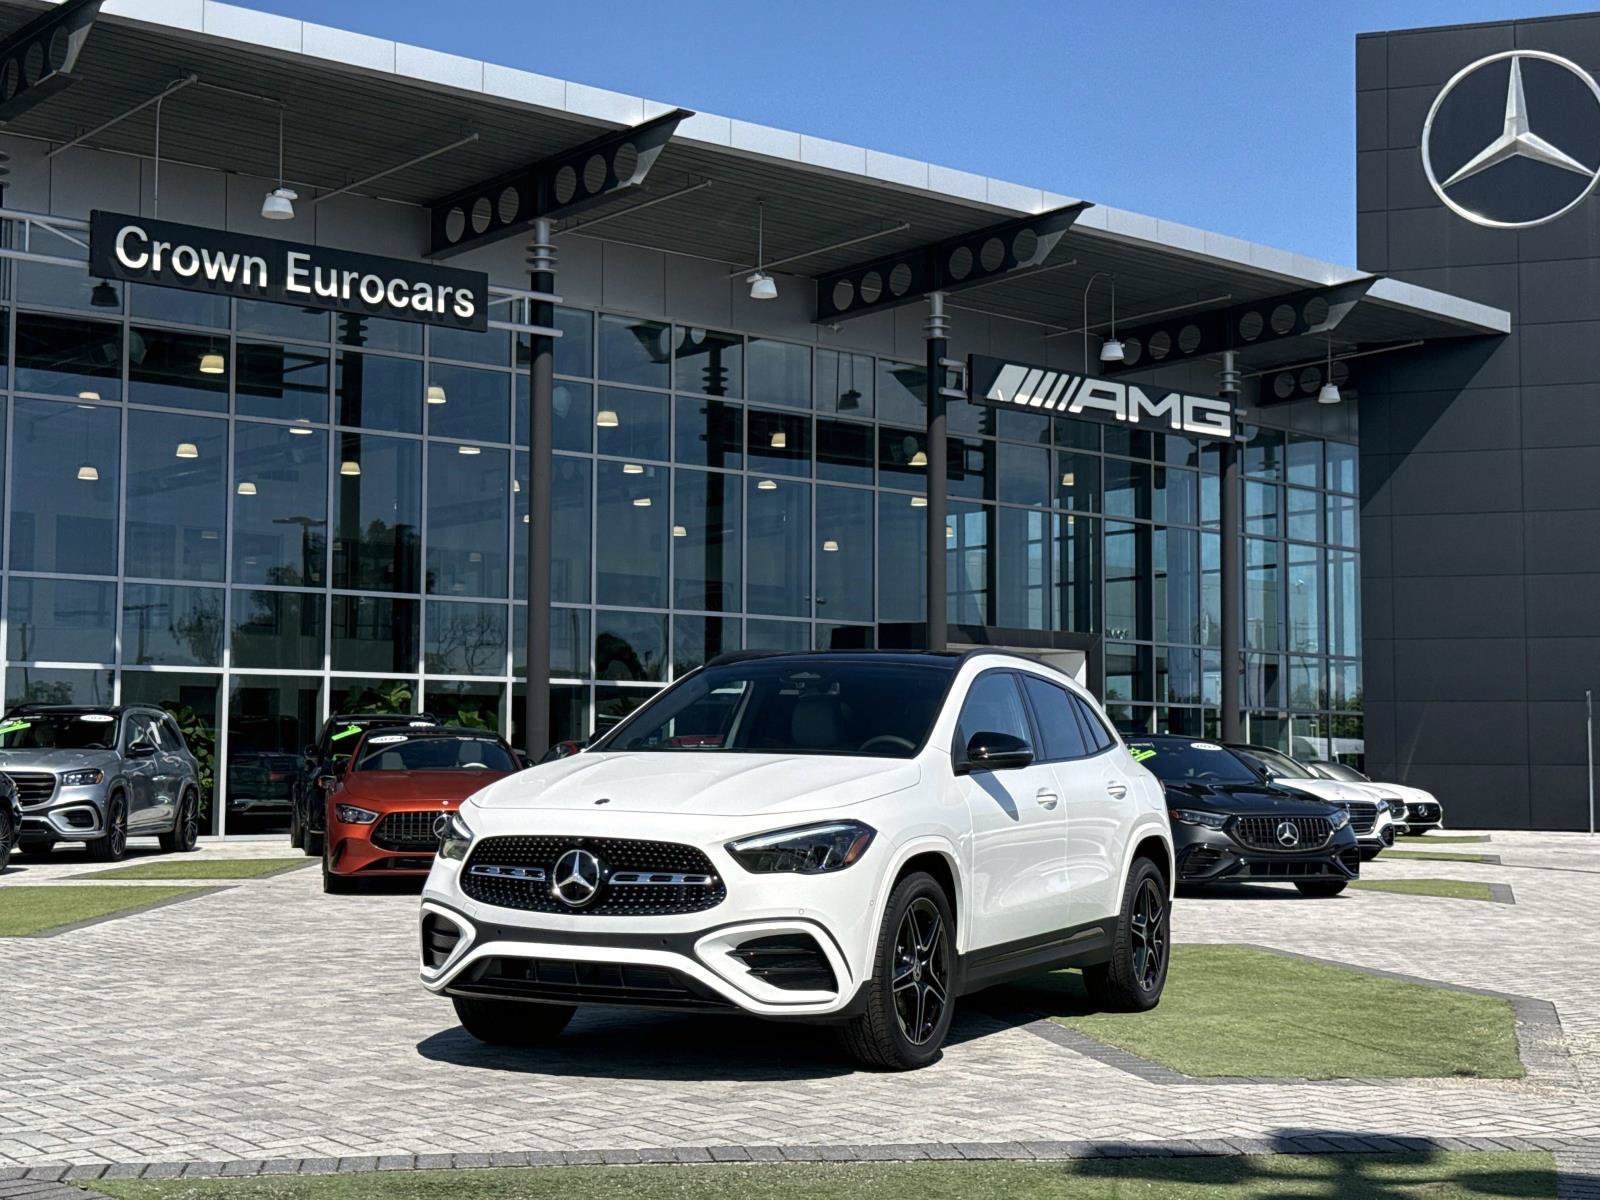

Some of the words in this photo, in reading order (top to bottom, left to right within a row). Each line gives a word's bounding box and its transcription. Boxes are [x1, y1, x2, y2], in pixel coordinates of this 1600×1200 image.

[115, 225, 268, 287] Crown
[286, 251, 475, 318] Eurocars
[1068, 378, 1232, 437] AMG
